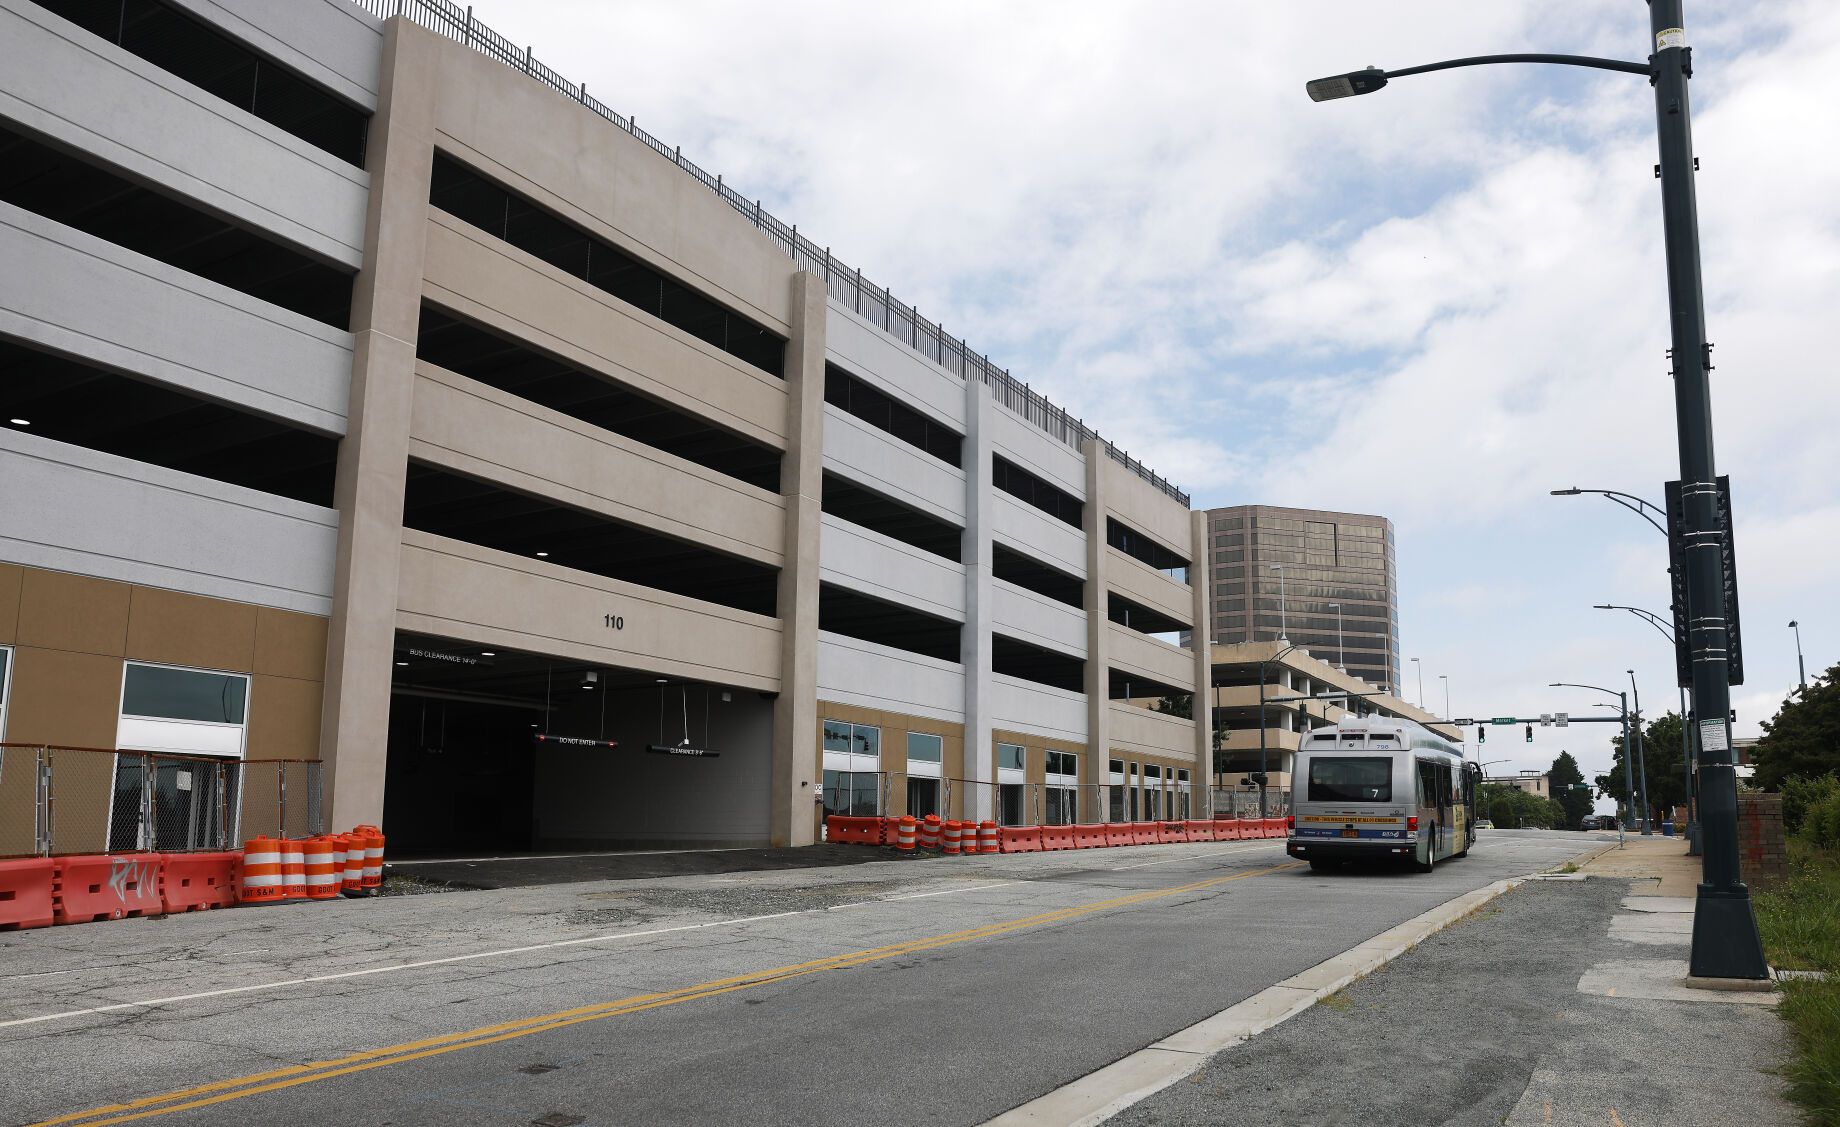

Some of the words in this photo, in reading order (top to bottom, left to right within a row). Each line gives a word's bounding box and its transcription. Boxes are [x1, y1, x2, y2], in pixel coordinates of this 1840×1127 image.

[604, 613, 624, 630] 110
[409, 648, 423, 657] BUS
[424, 650, 461, 663] CLEARANCE
[670, 747, 695, 755] CLEARANCE
[1371, 788, 1379, 798] 7
